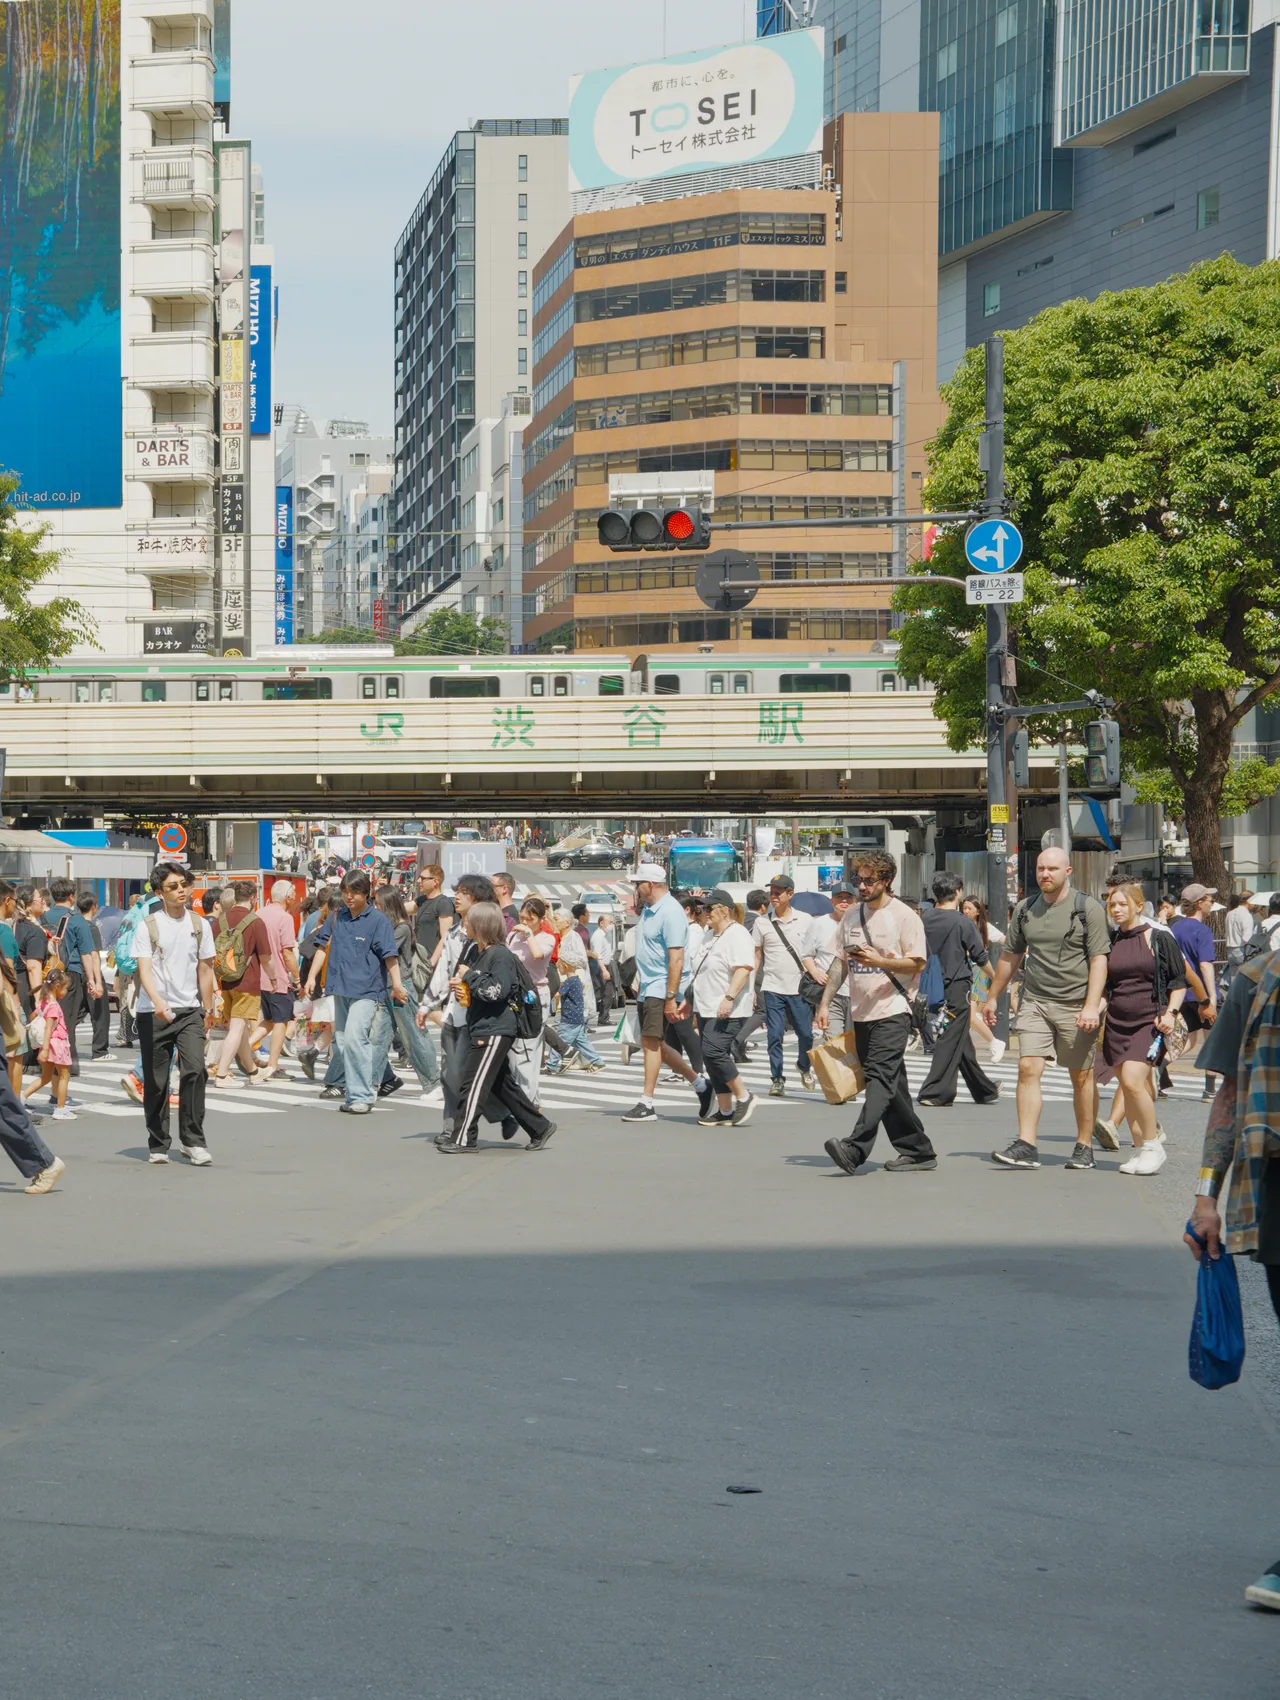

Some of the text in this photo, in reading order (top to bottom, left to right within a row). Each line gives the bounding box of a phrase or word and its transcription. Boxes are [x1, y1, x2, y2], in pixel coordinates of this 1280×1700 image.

[651, 67, 736, 93] 都市に、心を。
[630, 123, 757, 160] トーセイ株式会社
[642, 241, 699, 258] ダンディハウス
[712, 235, 732, 247] 11F
[230, 391, 242, 399] BAR
[136, 439, 190, 453] DARTS
[142, 453, 190, 467] & BAR
[3, 490, 81, 503] .hit-ad.co.jp
[223, 488, 231, 525] カラオケ
[277, 503, 288, 550] MIZUHO
[224, 539, 242, 552] 3F
[969, 577, 1020, 589] 路線バスを除く
[154, 626, 173, 636] BAR
[146, 640, 182, 650] カラオケ
[359, 712, 405, 739] JR
